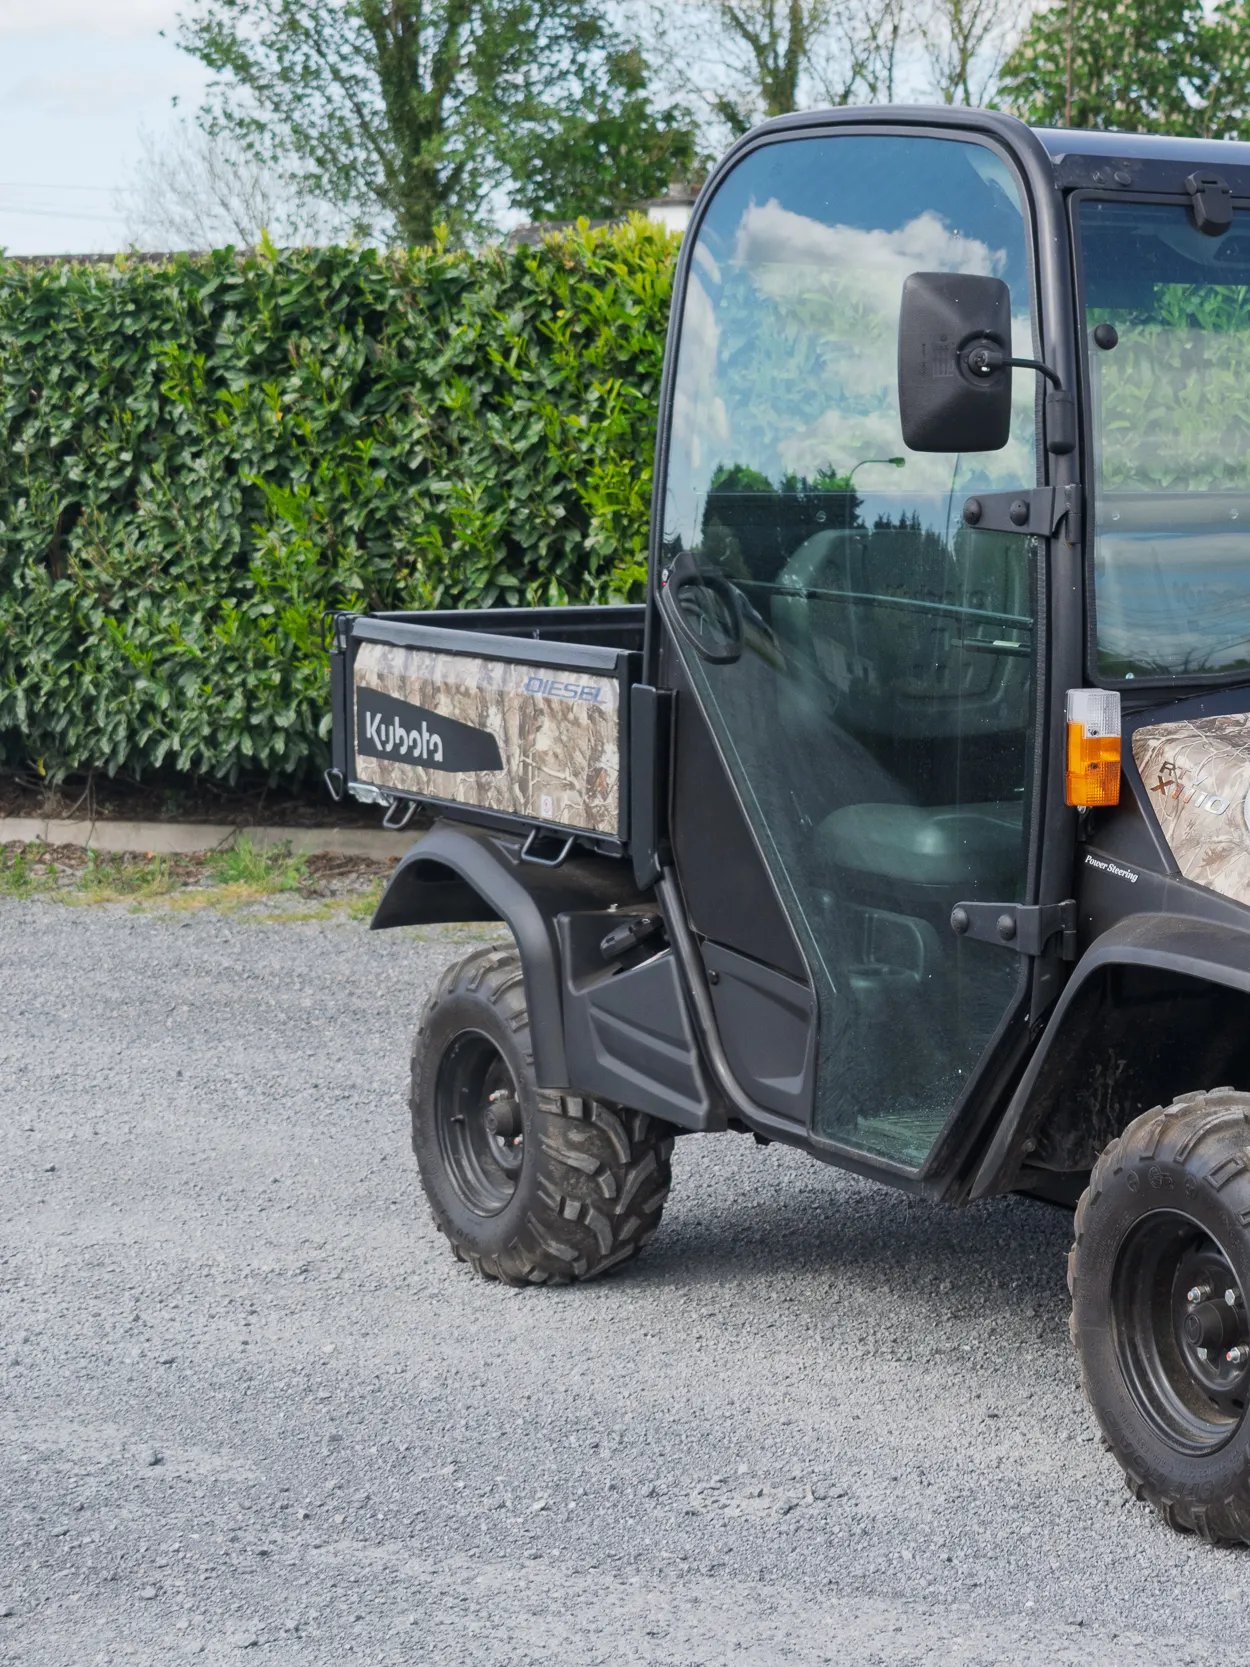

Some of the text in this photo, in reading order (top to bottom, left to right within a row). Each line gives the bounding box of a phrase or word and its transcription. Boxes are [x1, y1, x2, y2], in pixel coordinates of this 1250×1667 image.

[524, 676, 607, 704] DIESEL
[366, 711, 443, 762] Kubota
[1085, 854, 1138, 883] Power Steering
